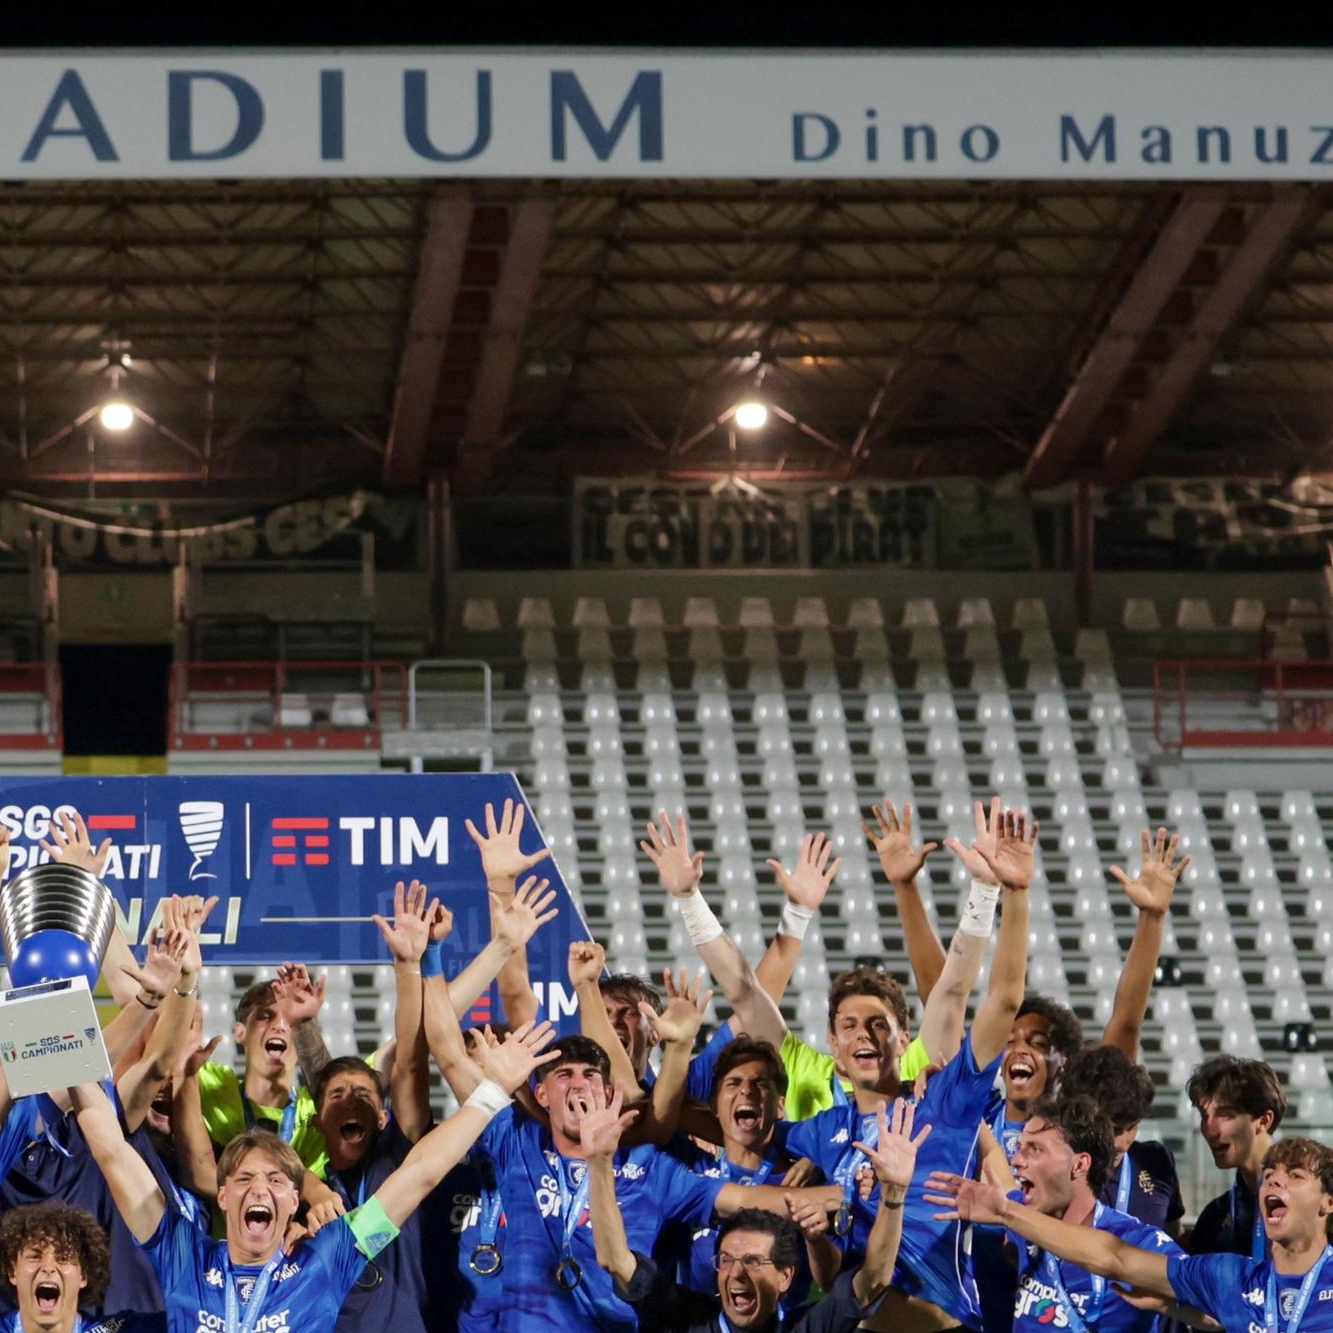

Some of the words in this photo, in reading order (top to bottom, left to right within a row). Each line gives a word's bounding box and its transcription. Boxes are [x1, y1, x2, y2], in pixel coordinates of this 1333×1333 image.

[792, 108, 1000, 163] Dino
[339, 816, 449, 865] TIM
[21, 1040, 83, 1060] CAMPIONATI
[39, 1035, 61, 1047] SGS
[198, 1309, 290, 1333] comuter
